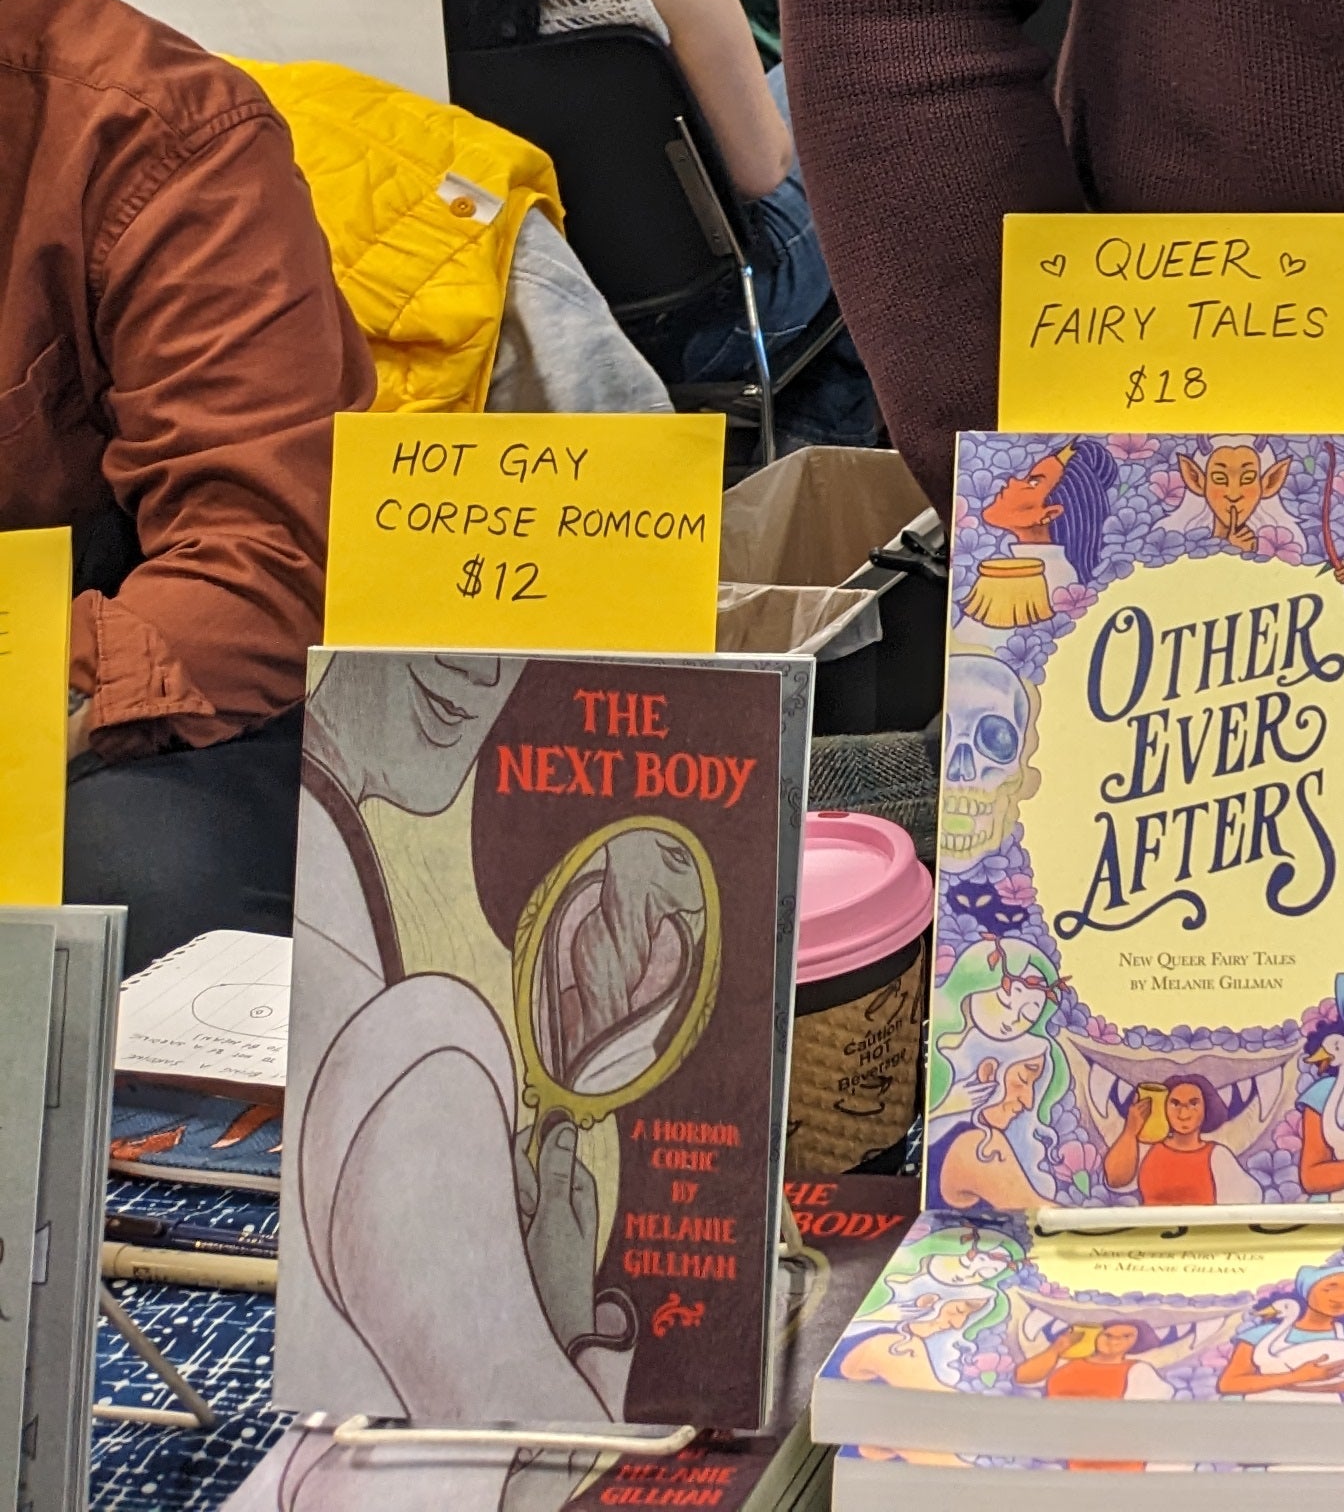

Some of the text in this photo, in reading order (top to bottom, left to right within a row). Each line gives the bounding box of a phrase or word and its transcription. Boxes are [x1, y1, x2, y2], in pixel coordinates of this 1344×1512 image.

[1095, 237, 1263, 281] QUEER
[1029, 300, 1328, 349] FAIRY TALES
[1125, 366, 1208, 409] $18
[392, 442, 588, 482] HOT GAY
[374, 498, 706, 542] CORPSE ROMCOM
[456, 552, 548, 602] $12
[573, 688, 669, 740] THE
[1100, 690, 1328, 804] EVER
[496, 744, 757, 809] NEXT BODY
[1053, 768, 1337, 941] AFTERS
[1118, 950, 1297, 969] NEW QUEER FAIRY TALES
[1151, 975, 1217, 990] MELANIE
[1222, 974, 1285, 990] GILLMAN
[842, 1019, 904, 1057] Caution
[857, 1037, 894, 1066] HOT
[631, 1118, 742, 1147] A HORROR
[651, 1148, 720, 1172] COMIC
[670, 1180, 700, 1204] BY
[625, 1211, 737, 1245] MELANIE
[793, 1211, 905, 1241] BODY
[623, 1248, 737, 1280] GILLMAN
[615, 1463, 737, 1484] MELANIE
[600, 1487, 723, 1507] GILLMAN
